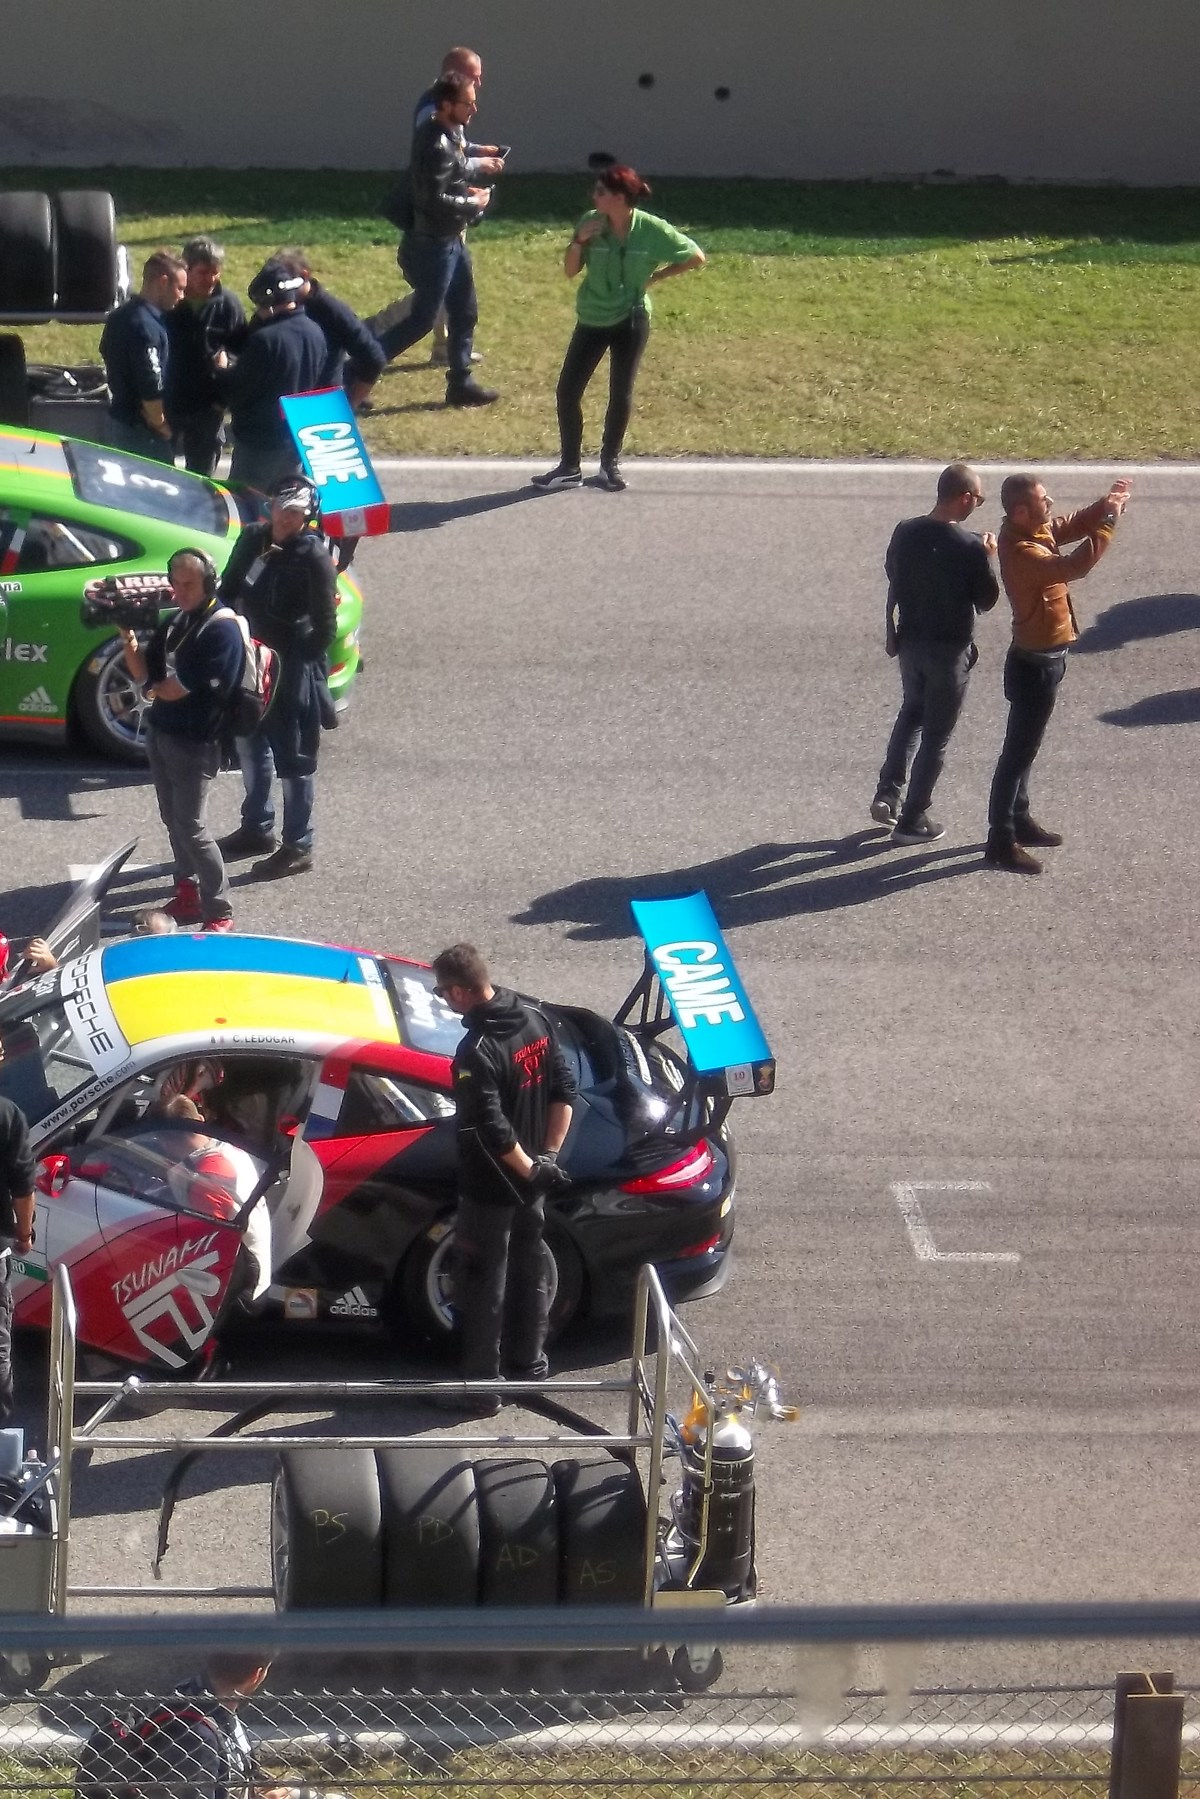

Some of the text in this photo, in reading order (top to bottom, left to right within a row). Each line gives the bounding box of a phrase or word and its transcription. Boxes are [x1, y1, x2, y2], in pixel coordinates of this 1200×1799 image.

[297, 421, 369, 487] CAME
[18, 702, 58, 713] adidas
[70, 953, 114, 1056] PORSCHE
[652, 940, 746, 1029] CAME
[40, 1060, 137, 1131] www.porsche.com
[111, 1231, 220, 1304] TSUNAMI
[329, 1304, 378, 1317] adidas
[495, 1541, 541, 1572] AD
[579, 1559, 618, 1587] AS
